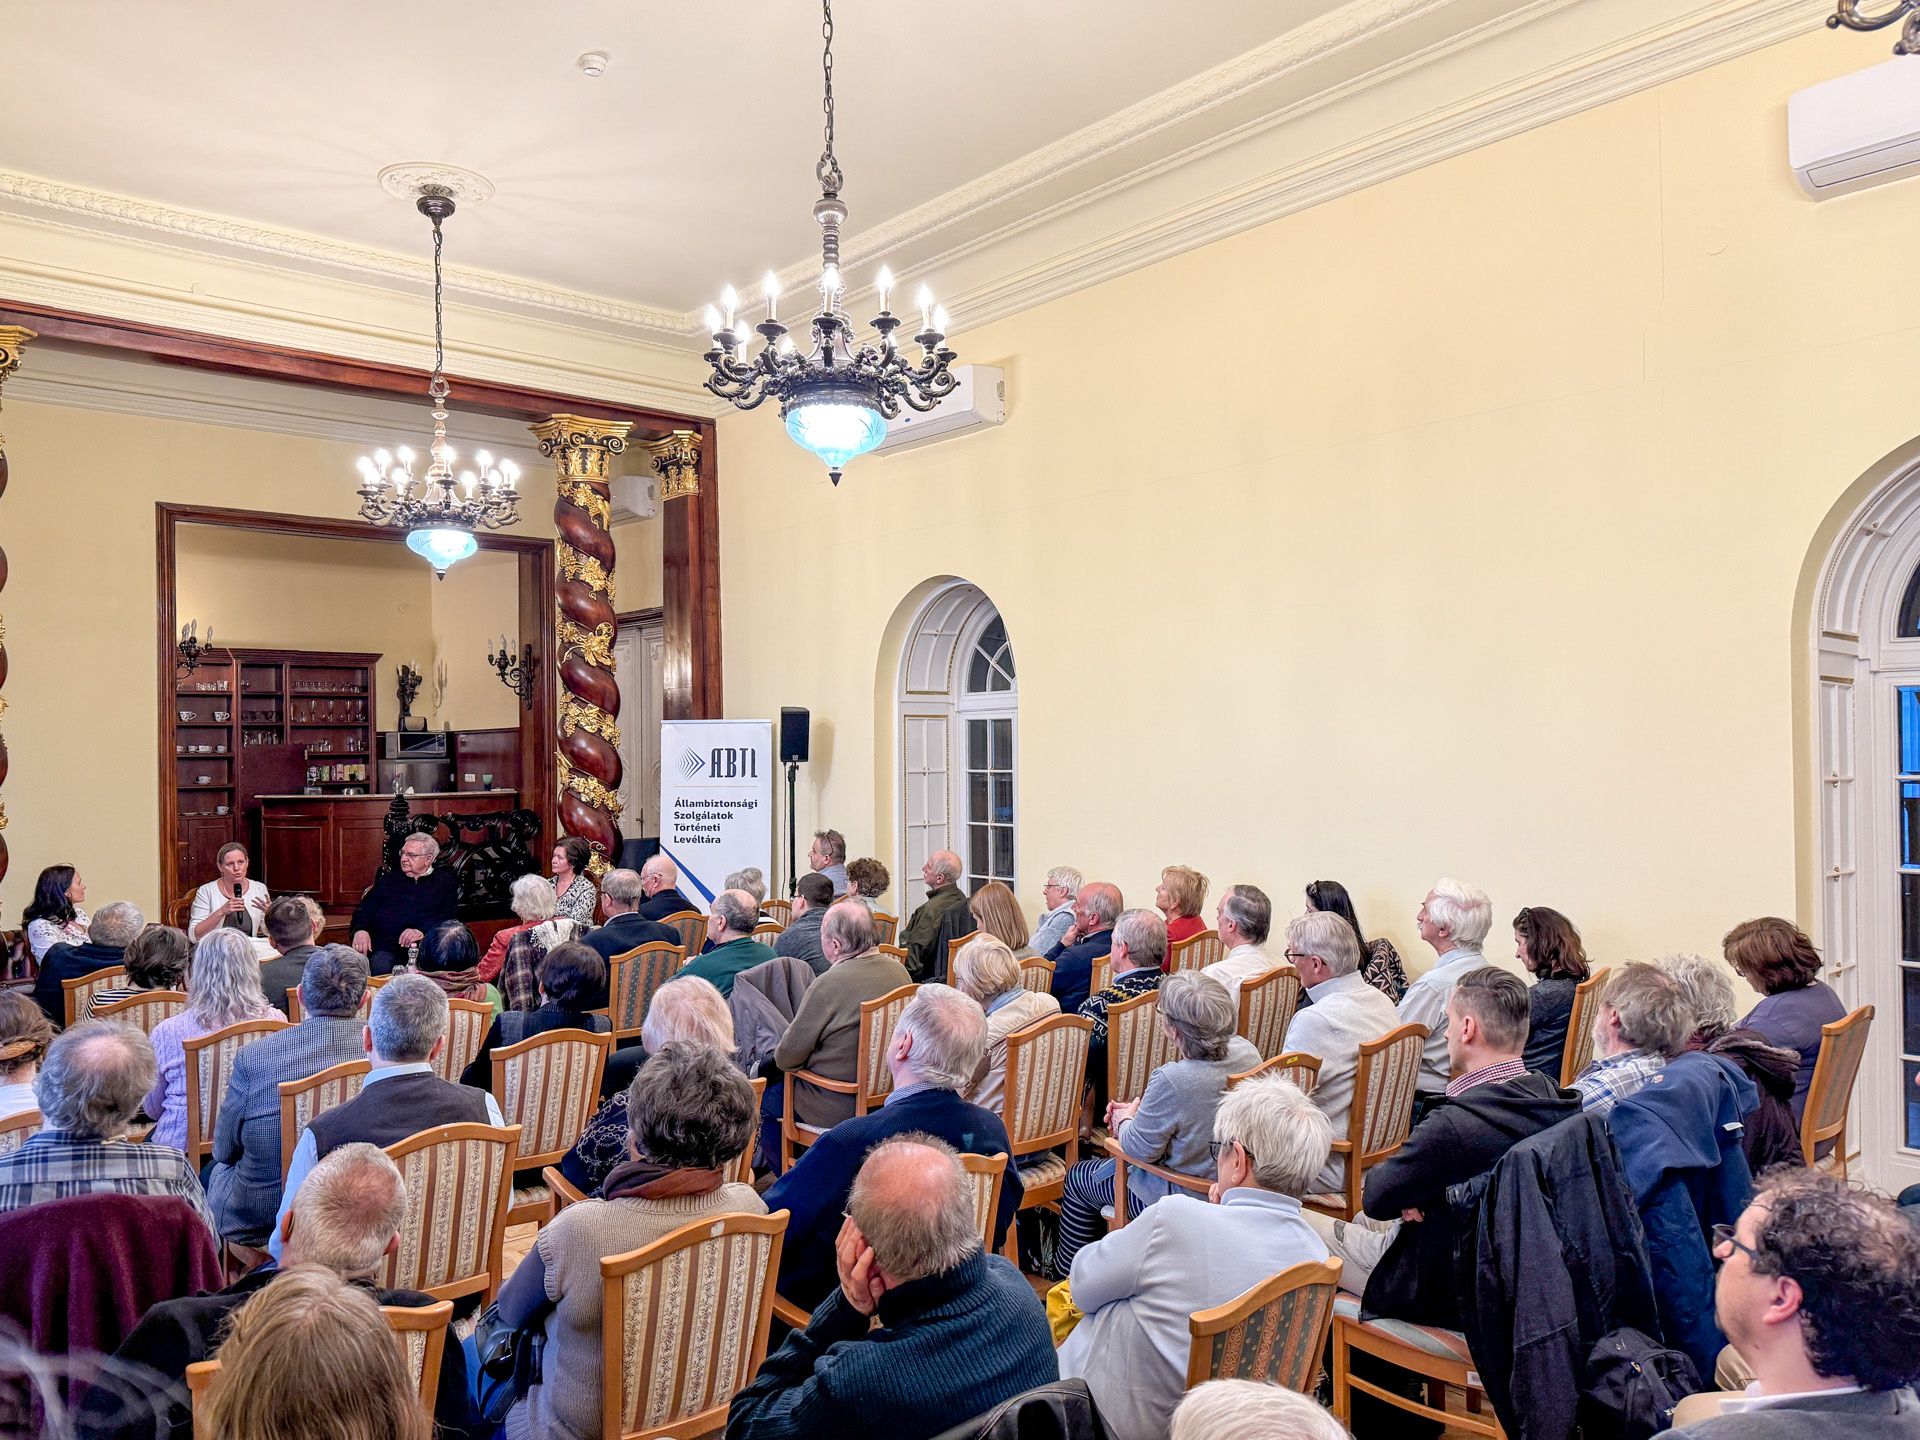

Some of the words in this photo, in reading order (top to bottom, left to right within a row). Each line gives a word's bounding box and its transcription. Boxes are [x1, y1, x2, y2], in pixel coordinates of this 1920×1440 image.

[708, 748, 758, 778] ABTL
[674, 797, 758, 809] Állambiztonsági
[673, 811, 734, 821] Szolgálatok
[673, 823, 721, 832] Történeti
[673, 835, 721, 844] Levéltára
